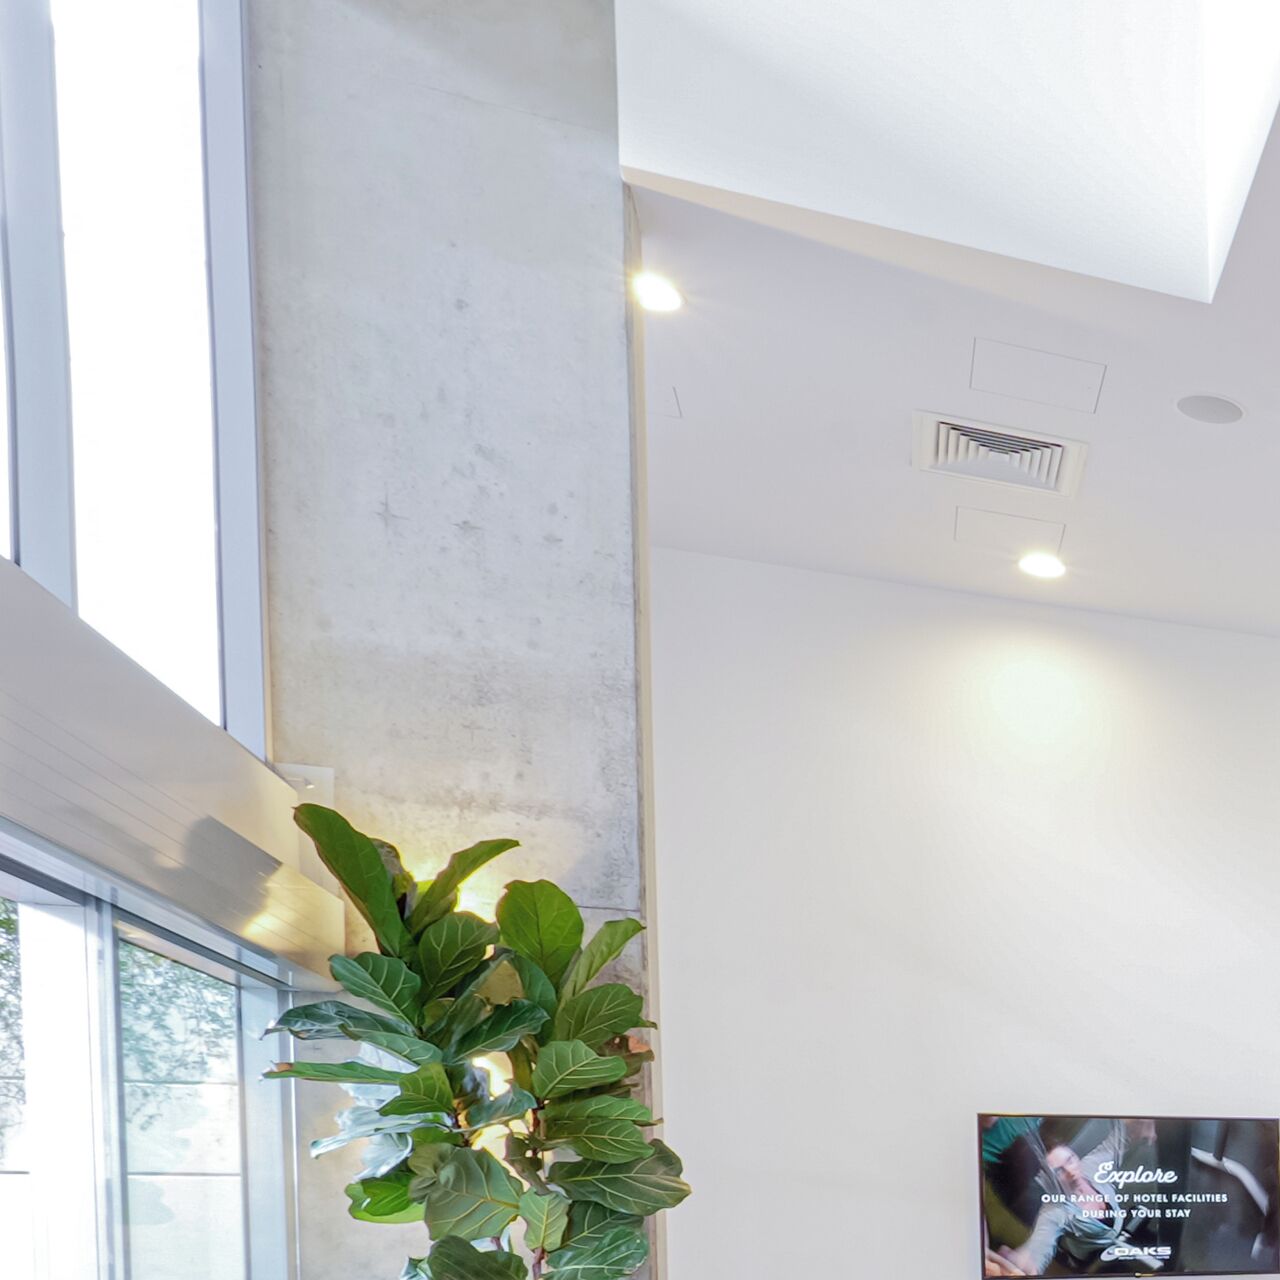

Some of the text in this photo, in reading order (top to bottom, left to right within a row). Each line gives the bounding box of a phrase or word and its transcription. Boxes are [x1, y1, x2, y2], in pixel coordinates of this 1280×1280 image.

[1093, 1160, 1178, 1190] Explore
[1040, 1193, 1228, 1203] OUR RANGE OF HOTEL FACILITIES
[1082, 1209, 1191, 1218] DURING YOUR STAY
[1114, 1246, 1172, 1256] OAKS
